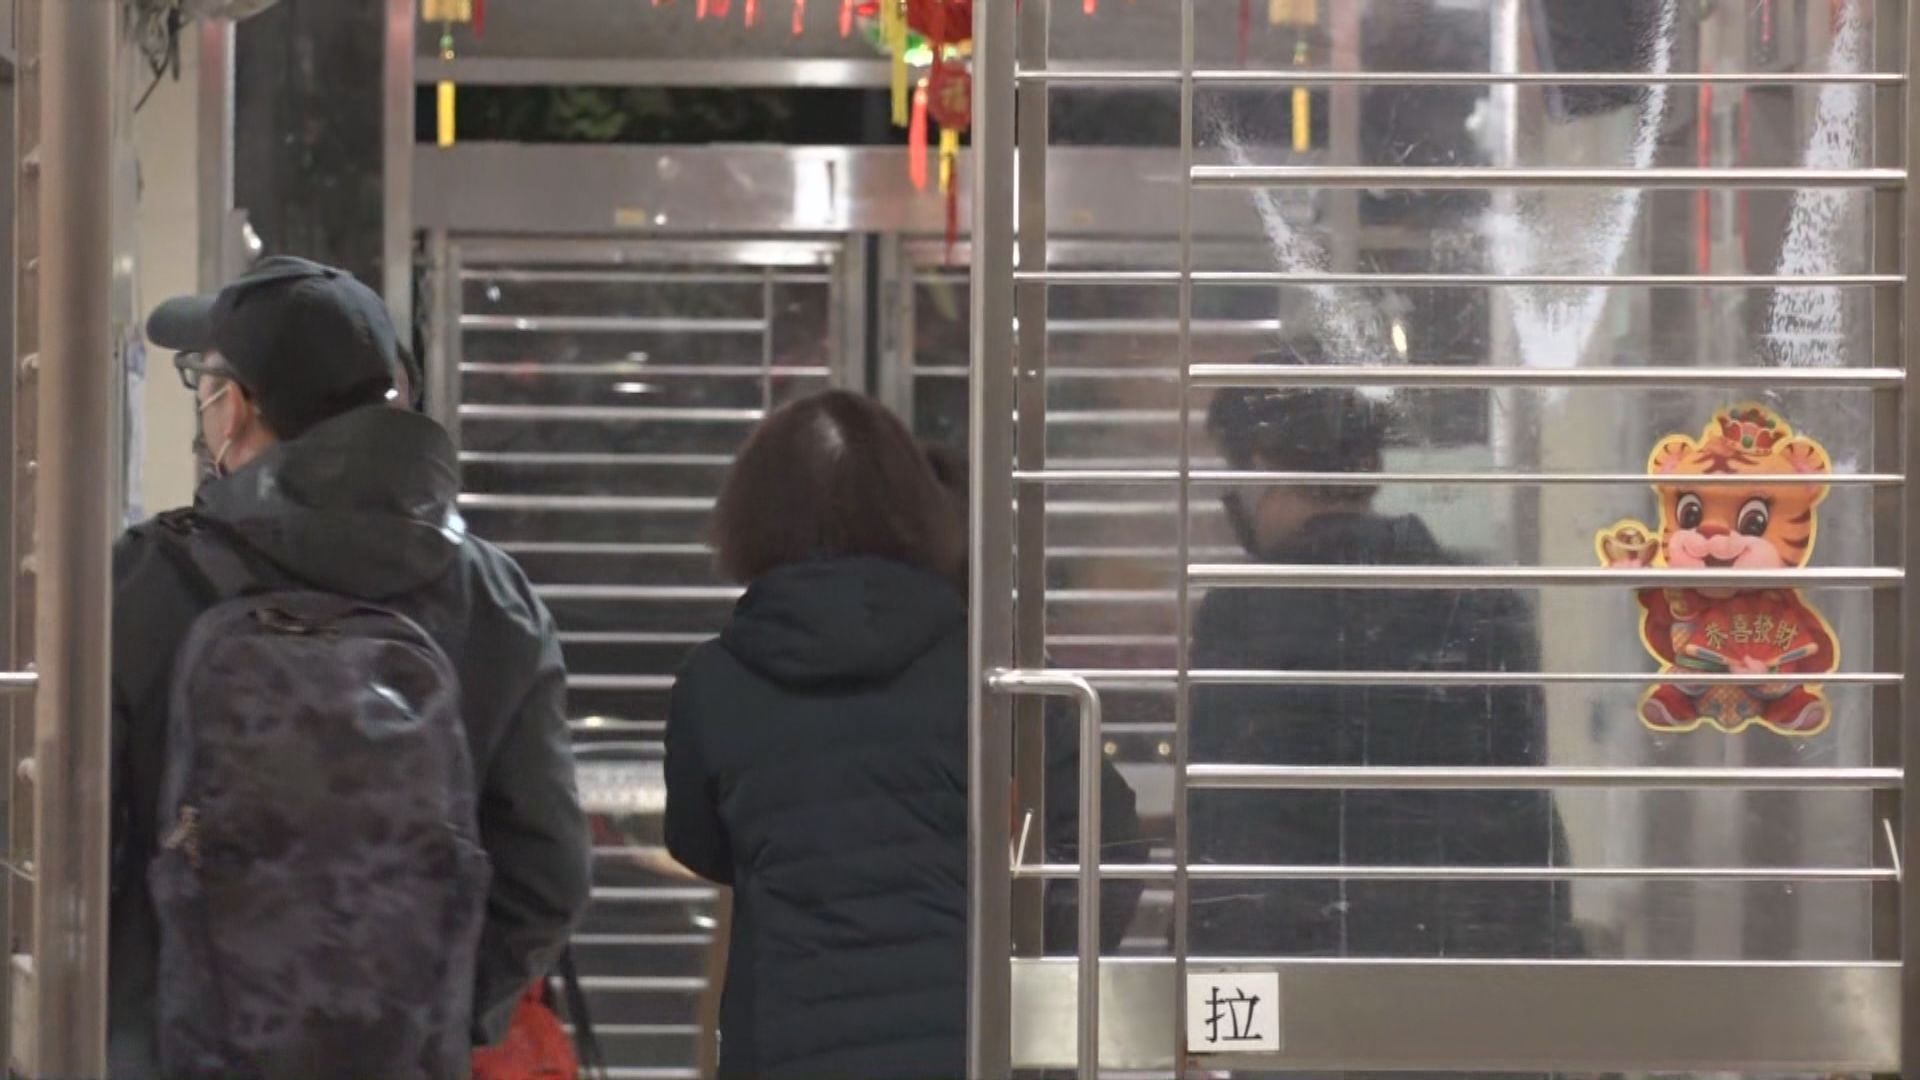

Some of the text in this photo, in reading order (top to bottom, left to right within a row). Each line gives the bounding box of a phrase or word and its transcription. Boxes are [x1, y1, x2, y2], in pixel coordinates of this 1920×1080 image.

[1705, 614, 1798, 651] 恭喜發財
[1205, 986, 1263, 1043] 拉
